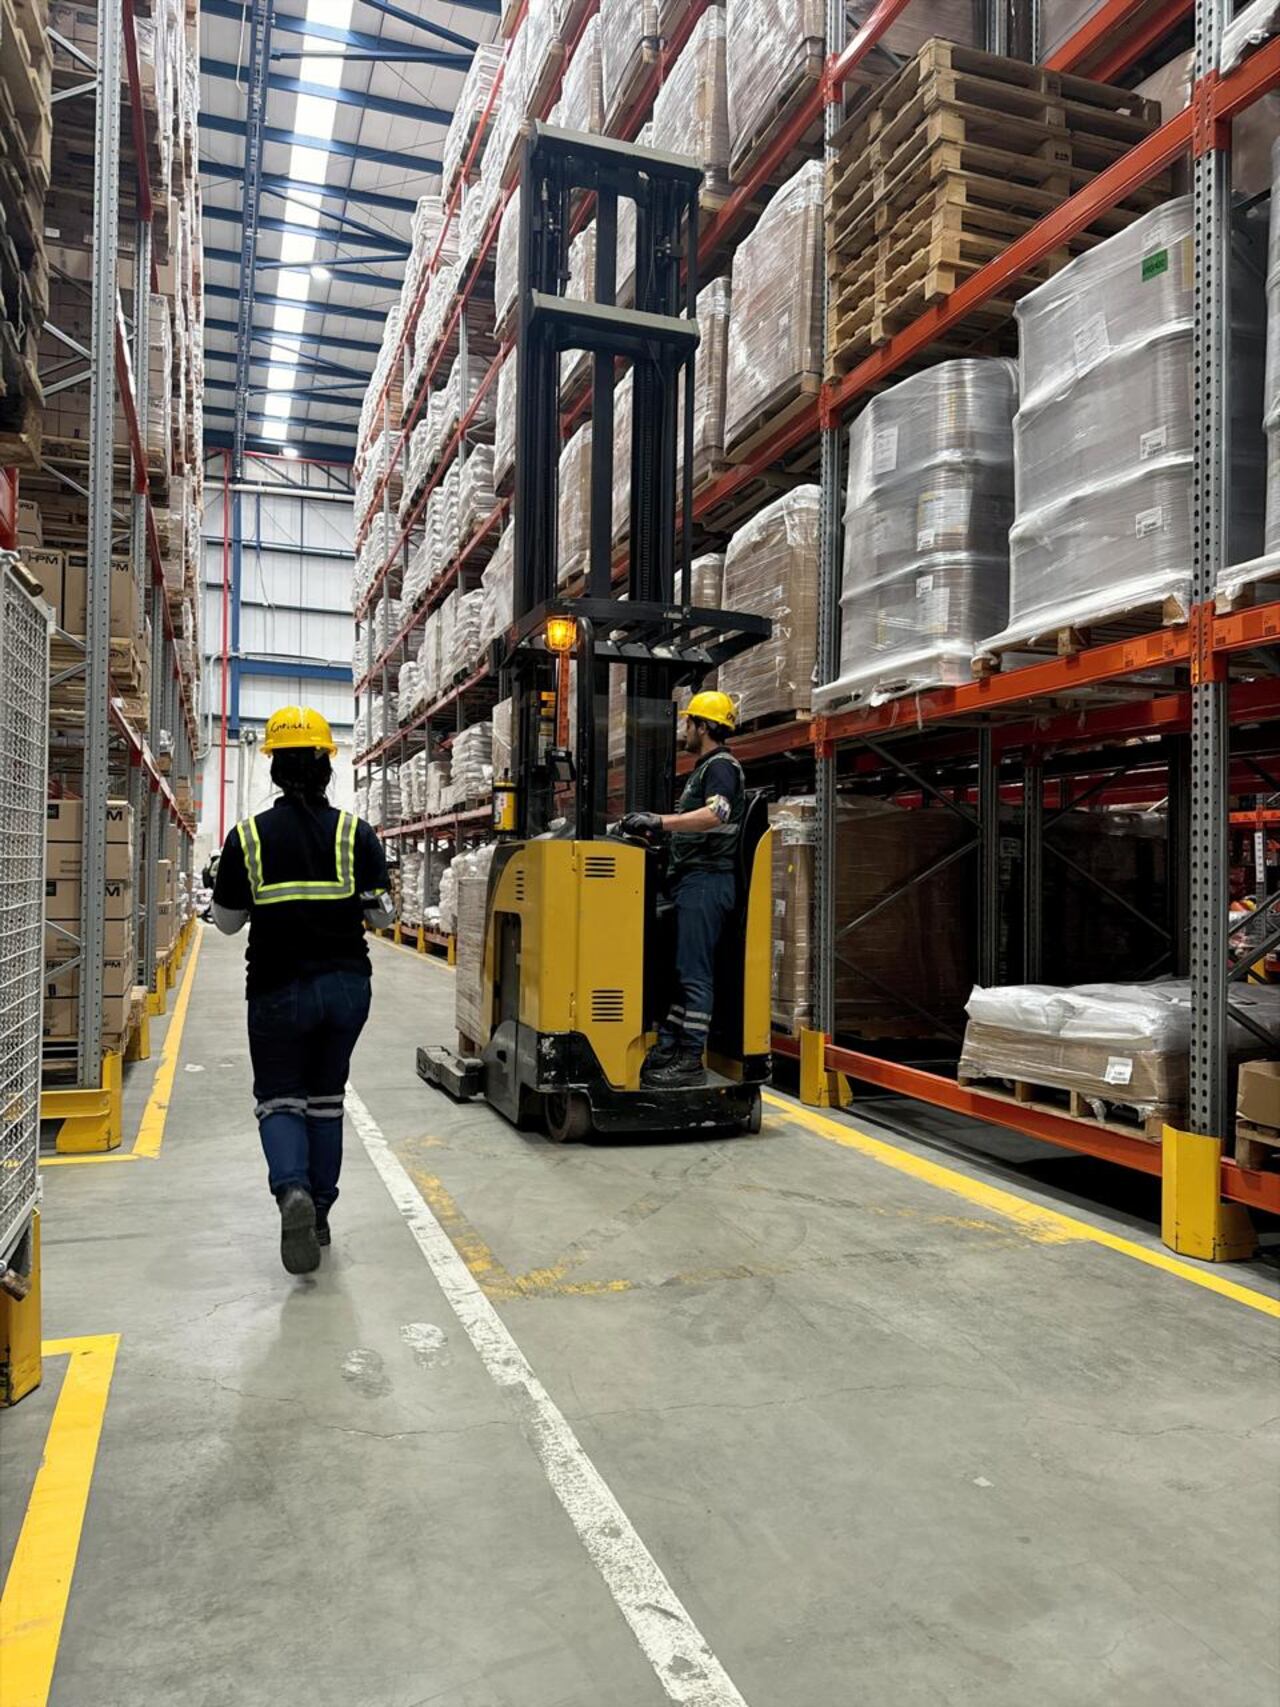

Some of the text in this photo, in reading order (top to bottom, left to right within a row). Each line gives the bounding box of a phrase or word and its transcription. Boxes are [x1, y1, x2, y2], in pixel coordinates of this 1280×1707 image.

[28, 554, 58, 565] HPM
[111, 562, 129, 572] PM
[103, 961, 121, 969] PM
